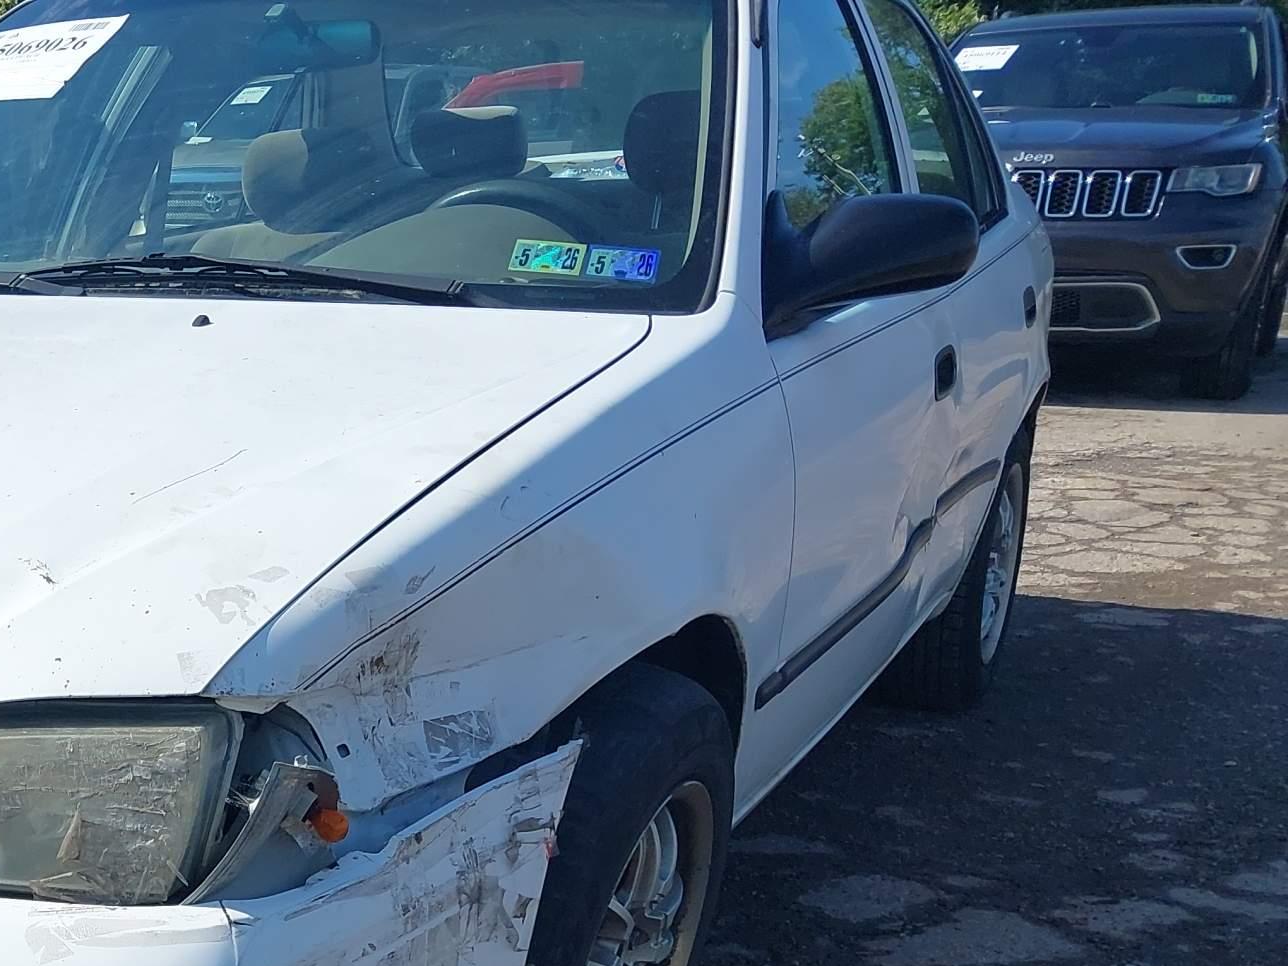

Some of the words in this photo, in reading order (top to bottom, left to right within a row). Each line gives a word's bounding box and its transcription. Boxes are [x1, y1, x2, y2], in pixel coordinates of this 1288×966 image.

[1013, 151, 1054, 165] Jeep
[561, 248, 580, 270] 26
[637, 253, 654, 277] 26
